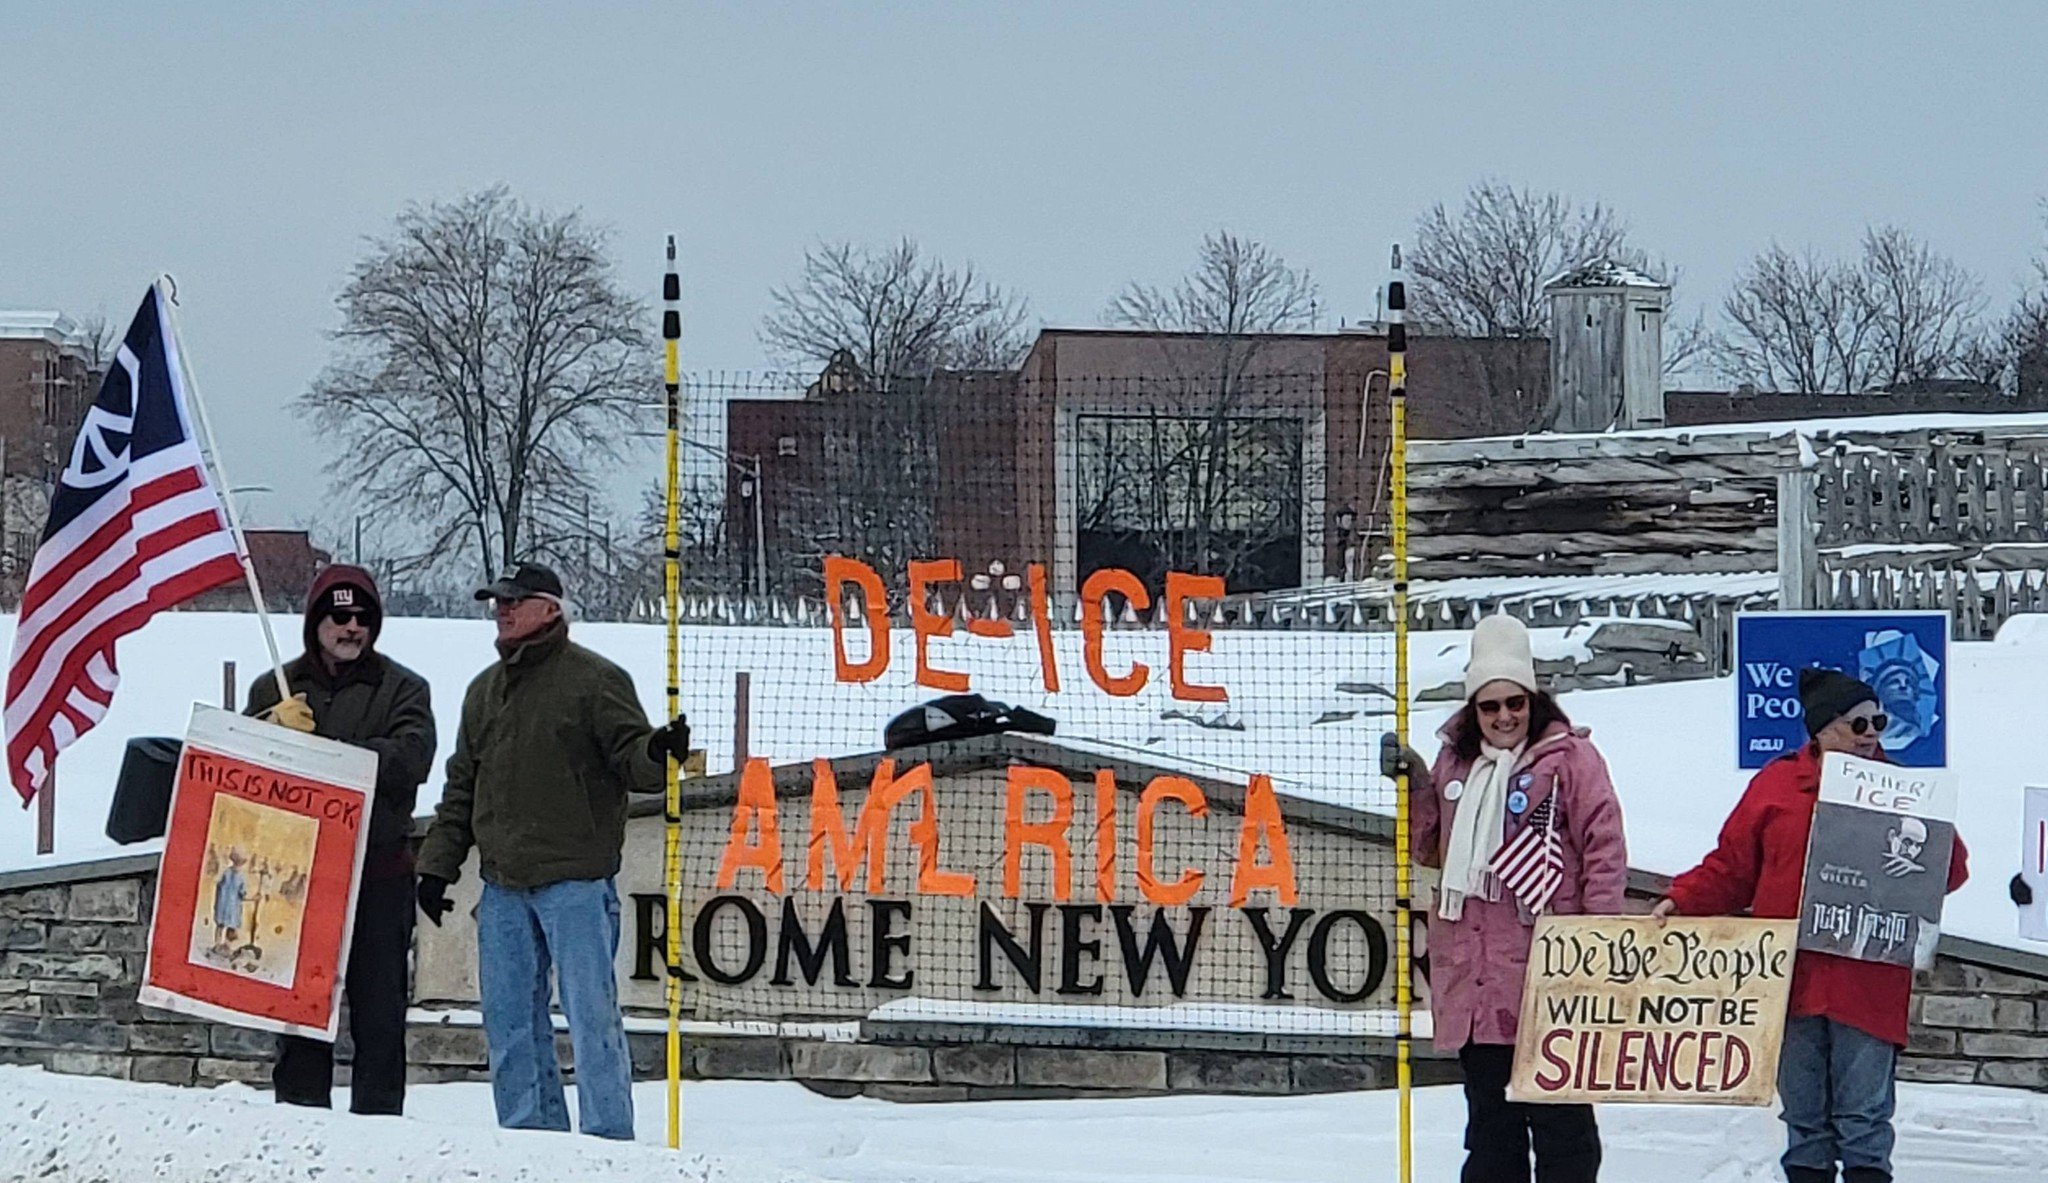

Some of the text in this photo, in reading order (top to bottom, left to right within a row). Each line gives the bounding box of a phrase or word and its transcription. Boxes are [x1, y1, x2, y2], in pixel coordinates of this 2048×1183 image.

[823, 556, 1228, 702] DE-ICE
[1745, 662, 1793, 688] We
[1746, 693, 1803, 719] Peo
[1750, 738, 1784, 751] ACLU
[187, 754, 360, 830] THIS IS NOT OK
[1855, 785, 1917, 810] ICE
[628, 893, 1431, 1004] ROME NEW YOR
[1538, 926, 1787, 994] We the People
[1547, 995, 1759, 1026] WILL NOT BE
[1534, 1028, 1751, 1092] SILENCED
